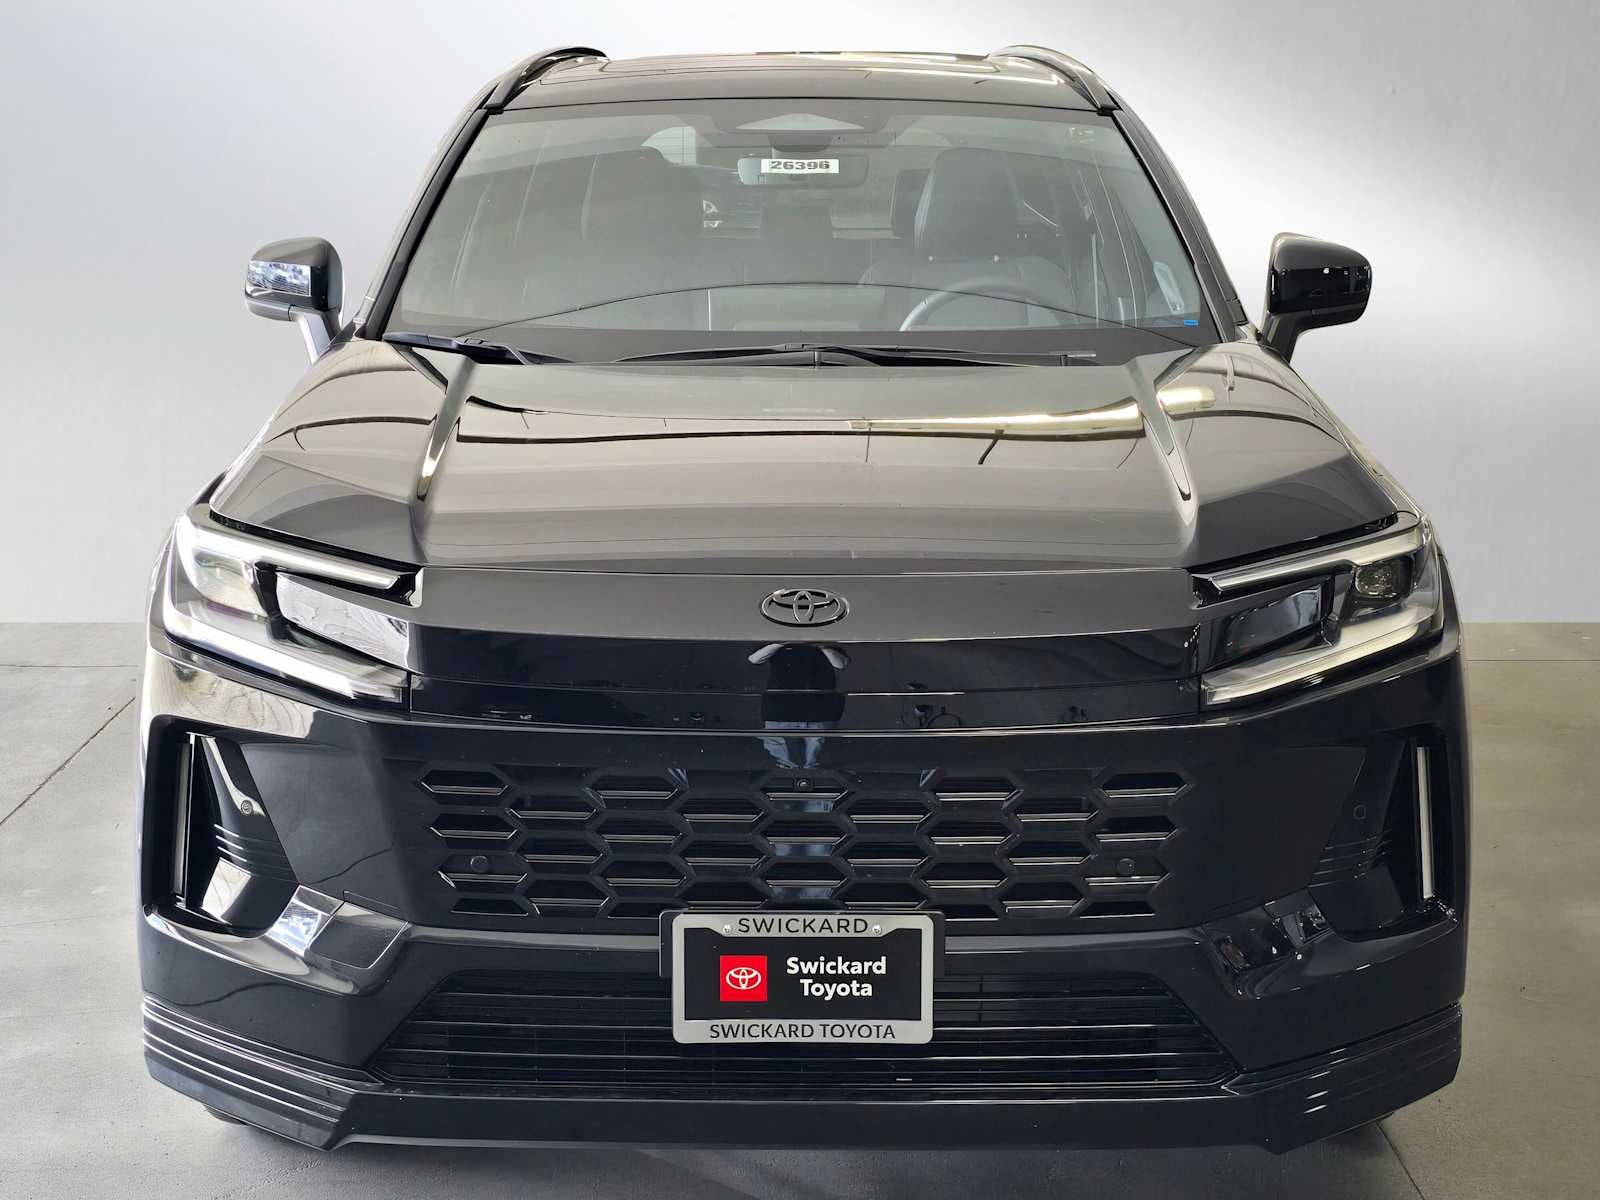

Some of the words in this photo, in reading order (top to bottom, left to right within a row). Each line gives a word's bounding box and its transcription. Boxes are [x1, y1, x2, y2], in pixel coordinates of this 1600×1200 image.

[770, 160, 830, 170] 26396
[737, 918, 868, 933] SWICKARD
[786, 956, 886, 975] Swickard
[800, 979, 873, 1000] Toyota
[709, 1023, 814, 1039] SWICKARD
[819, 1023, 896, 1039] TOYOTA
